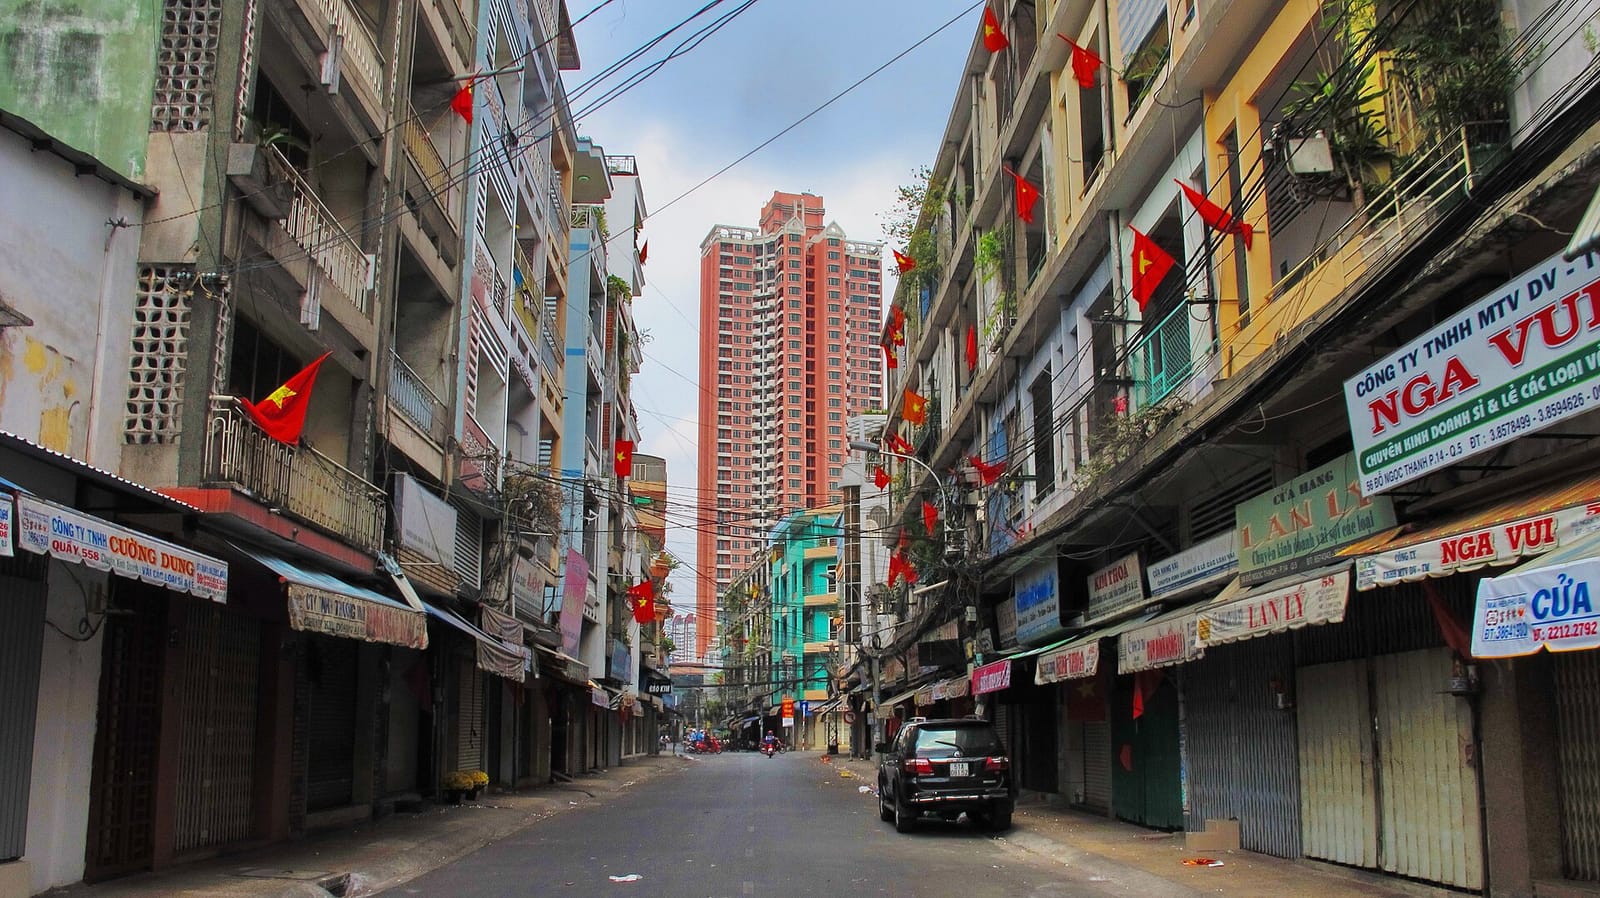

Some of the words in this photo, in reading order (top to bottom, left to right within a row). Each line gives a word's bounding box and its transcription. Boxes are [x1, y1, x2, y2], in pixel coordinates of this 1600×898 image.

[1356, 364, 1396, 397] CÔNG
[1398, 348, 1418, 373] TY
[1423, 318, 1472, 359] TNHH
[1478, 289, 1519, 330] MTV
[1527, 267, 1556, 302] DV
[1367, 355, 1480, 437] NGA
[1487, 277, 1600, 368] VUI
[1365, 442, 1402, 468] CHUYÊN
[1403, 429, 1429, 452] KINH
[1431, 410, 1471, 440] DOANH
[1487, 399, 1499, 414] &
[1501, 384, 1519, 408] LẺ
[1520, 375, 1547, 399] CÁC
[1548, 359, 1584, 382] LOẠI
[1366, 480, 1374, 492] 56
[1429, 450, 1444, 466] P.14
[1449, 442, 1463, 458] Q.5
[1489, 414, 1531, 441] 3.8578499
[1537, 393, 1585, 422] 3.8594626
[52, 515, 74, 537] CÔNG
[75, 525, 85, 541] TY
[88, 528, 108, 548] TNHH
[1242, 498, 1313, 551] LAN
[1441, 531, 1494, 564] NGA
[1505, 517, 1555, 550] VUI
[82, 548, 99, 561] 558
[109, 536, 157, 566] CƯỜNG
[161, 552, 194, 577] DUNG
[1108, 563, 1128, 585] THOA
[1394, 551, 1409, 563] CÔNG
[1409, 549, 1417, 560] TY
[1248, 598, 1278, 628] LAN
[1532, 573, 1592, 620] CỬA
[1547, 621, 1598, 641] 2212.2792
